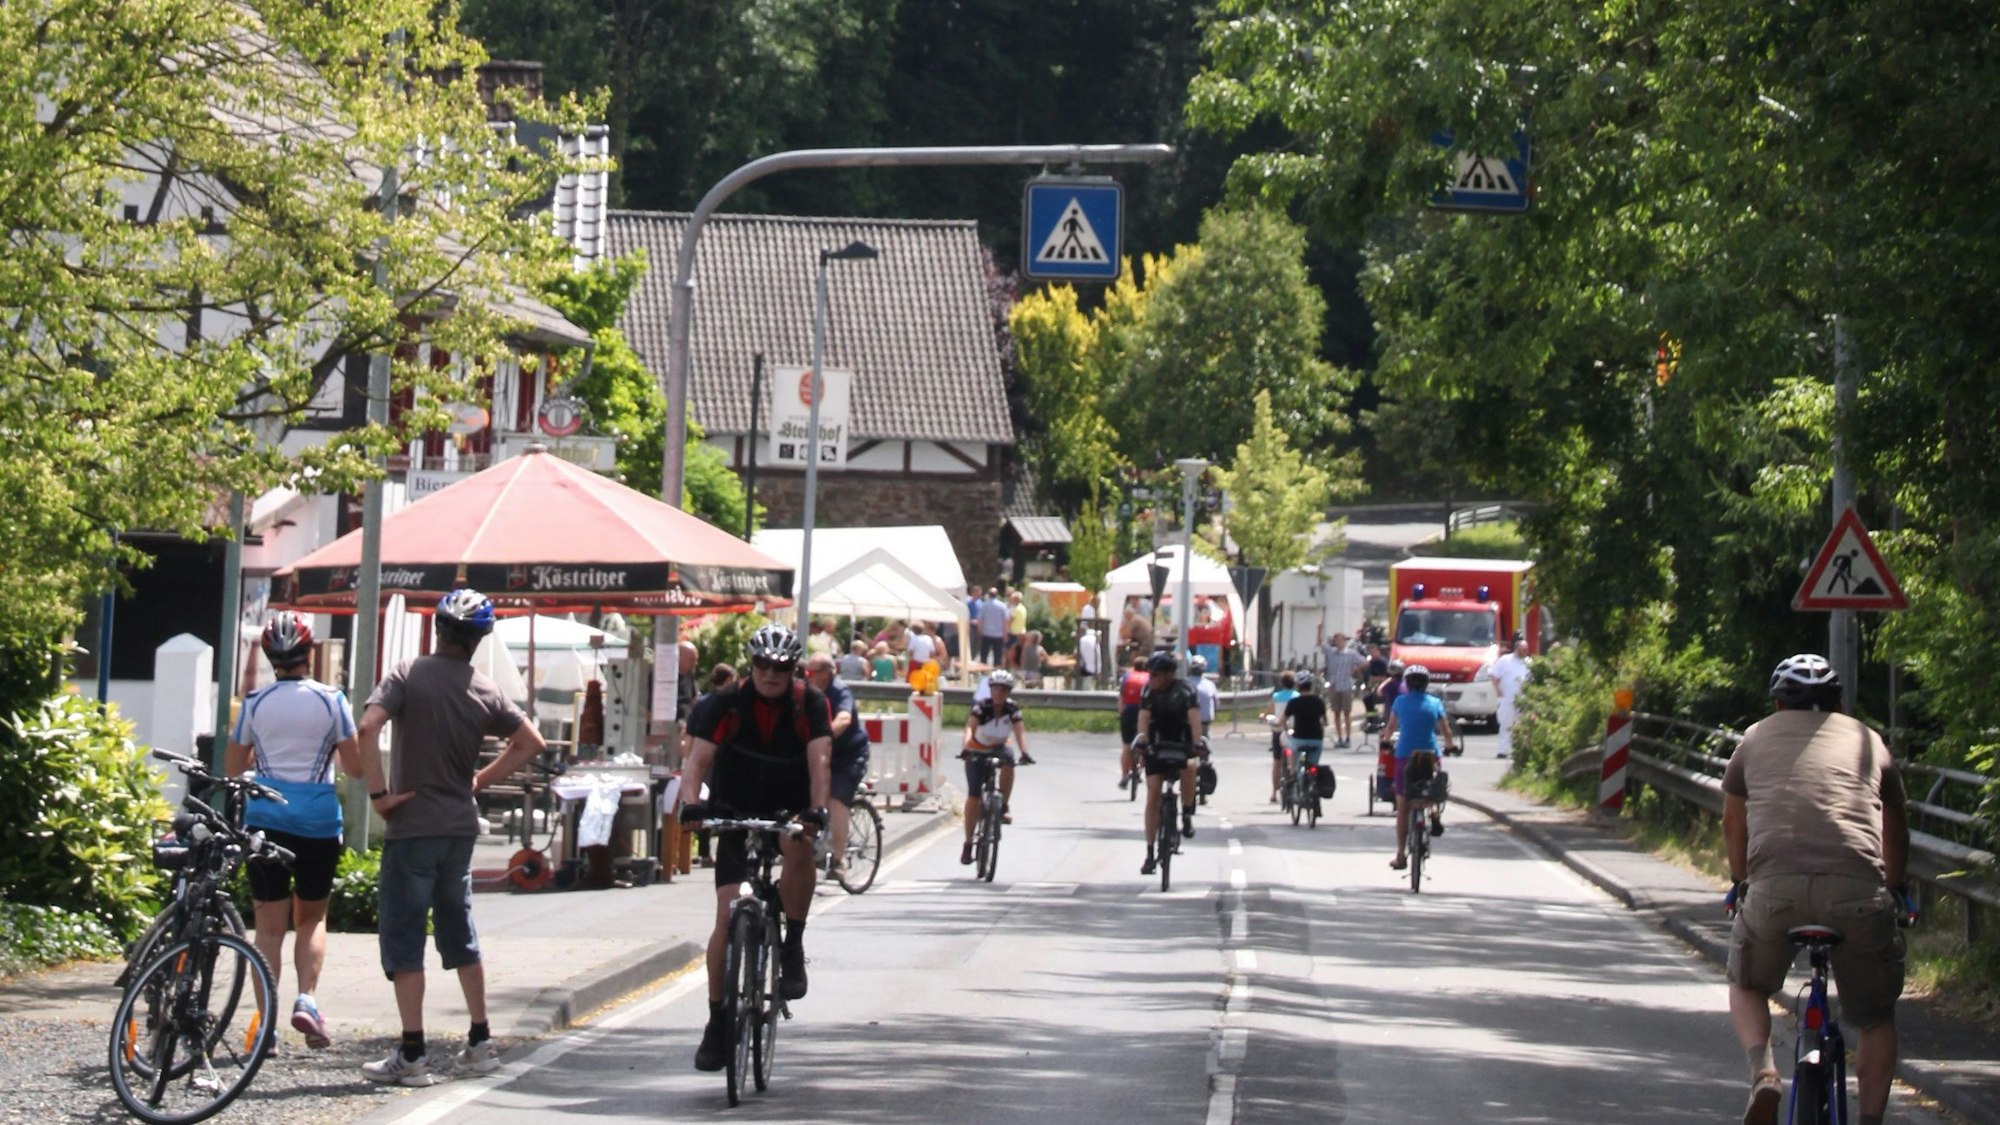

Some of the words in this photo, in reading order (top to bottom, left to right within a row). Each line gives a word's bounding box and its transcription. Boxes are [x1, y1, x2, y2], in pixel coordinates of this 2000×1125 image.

[778, 422, 841, 443] Steihof
[532, 566, 627, 590] Köstritzer
[709, 567, 768, 593] Köstritzer
